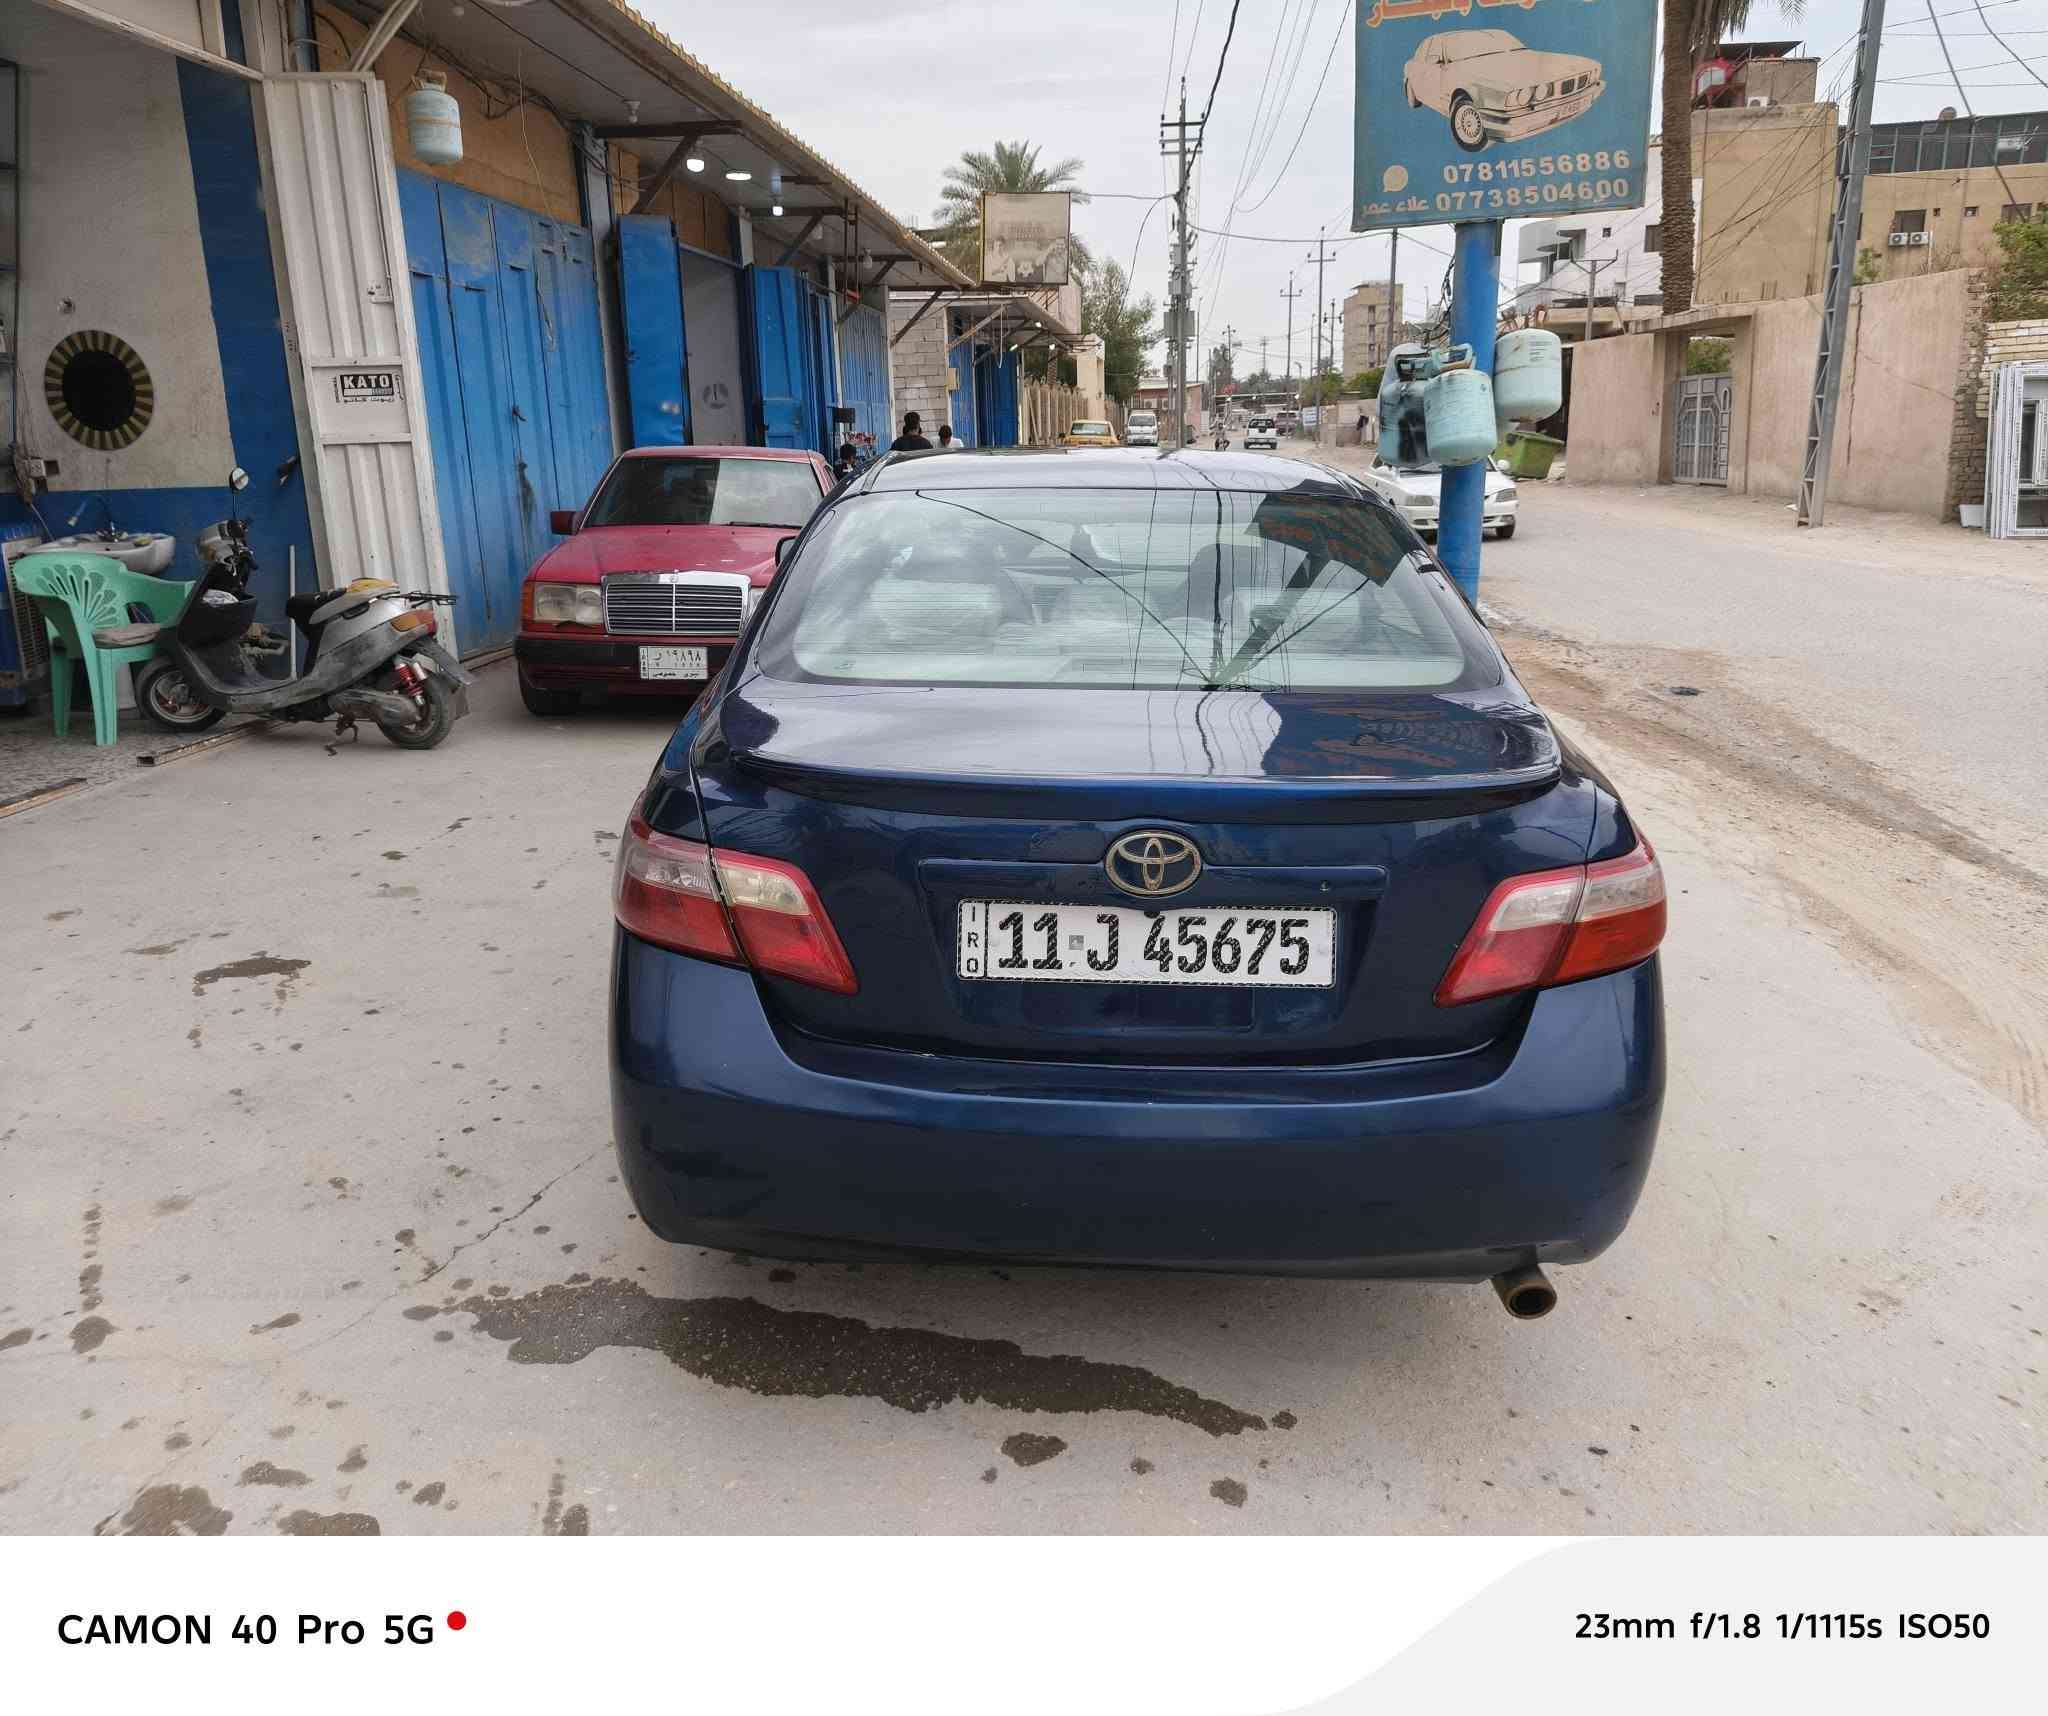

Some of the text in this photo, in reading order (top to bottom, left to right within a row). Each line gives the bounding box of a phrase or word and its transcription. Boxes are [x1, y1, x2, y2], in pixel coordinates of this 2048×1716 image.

[1443, 150, 1630, 184] 07811556886
[1436, 178, 1629, 211] 07738504600
[344, 375, 390, 389] KATO
[999, 912, 1310, 975] 11 J 45675
